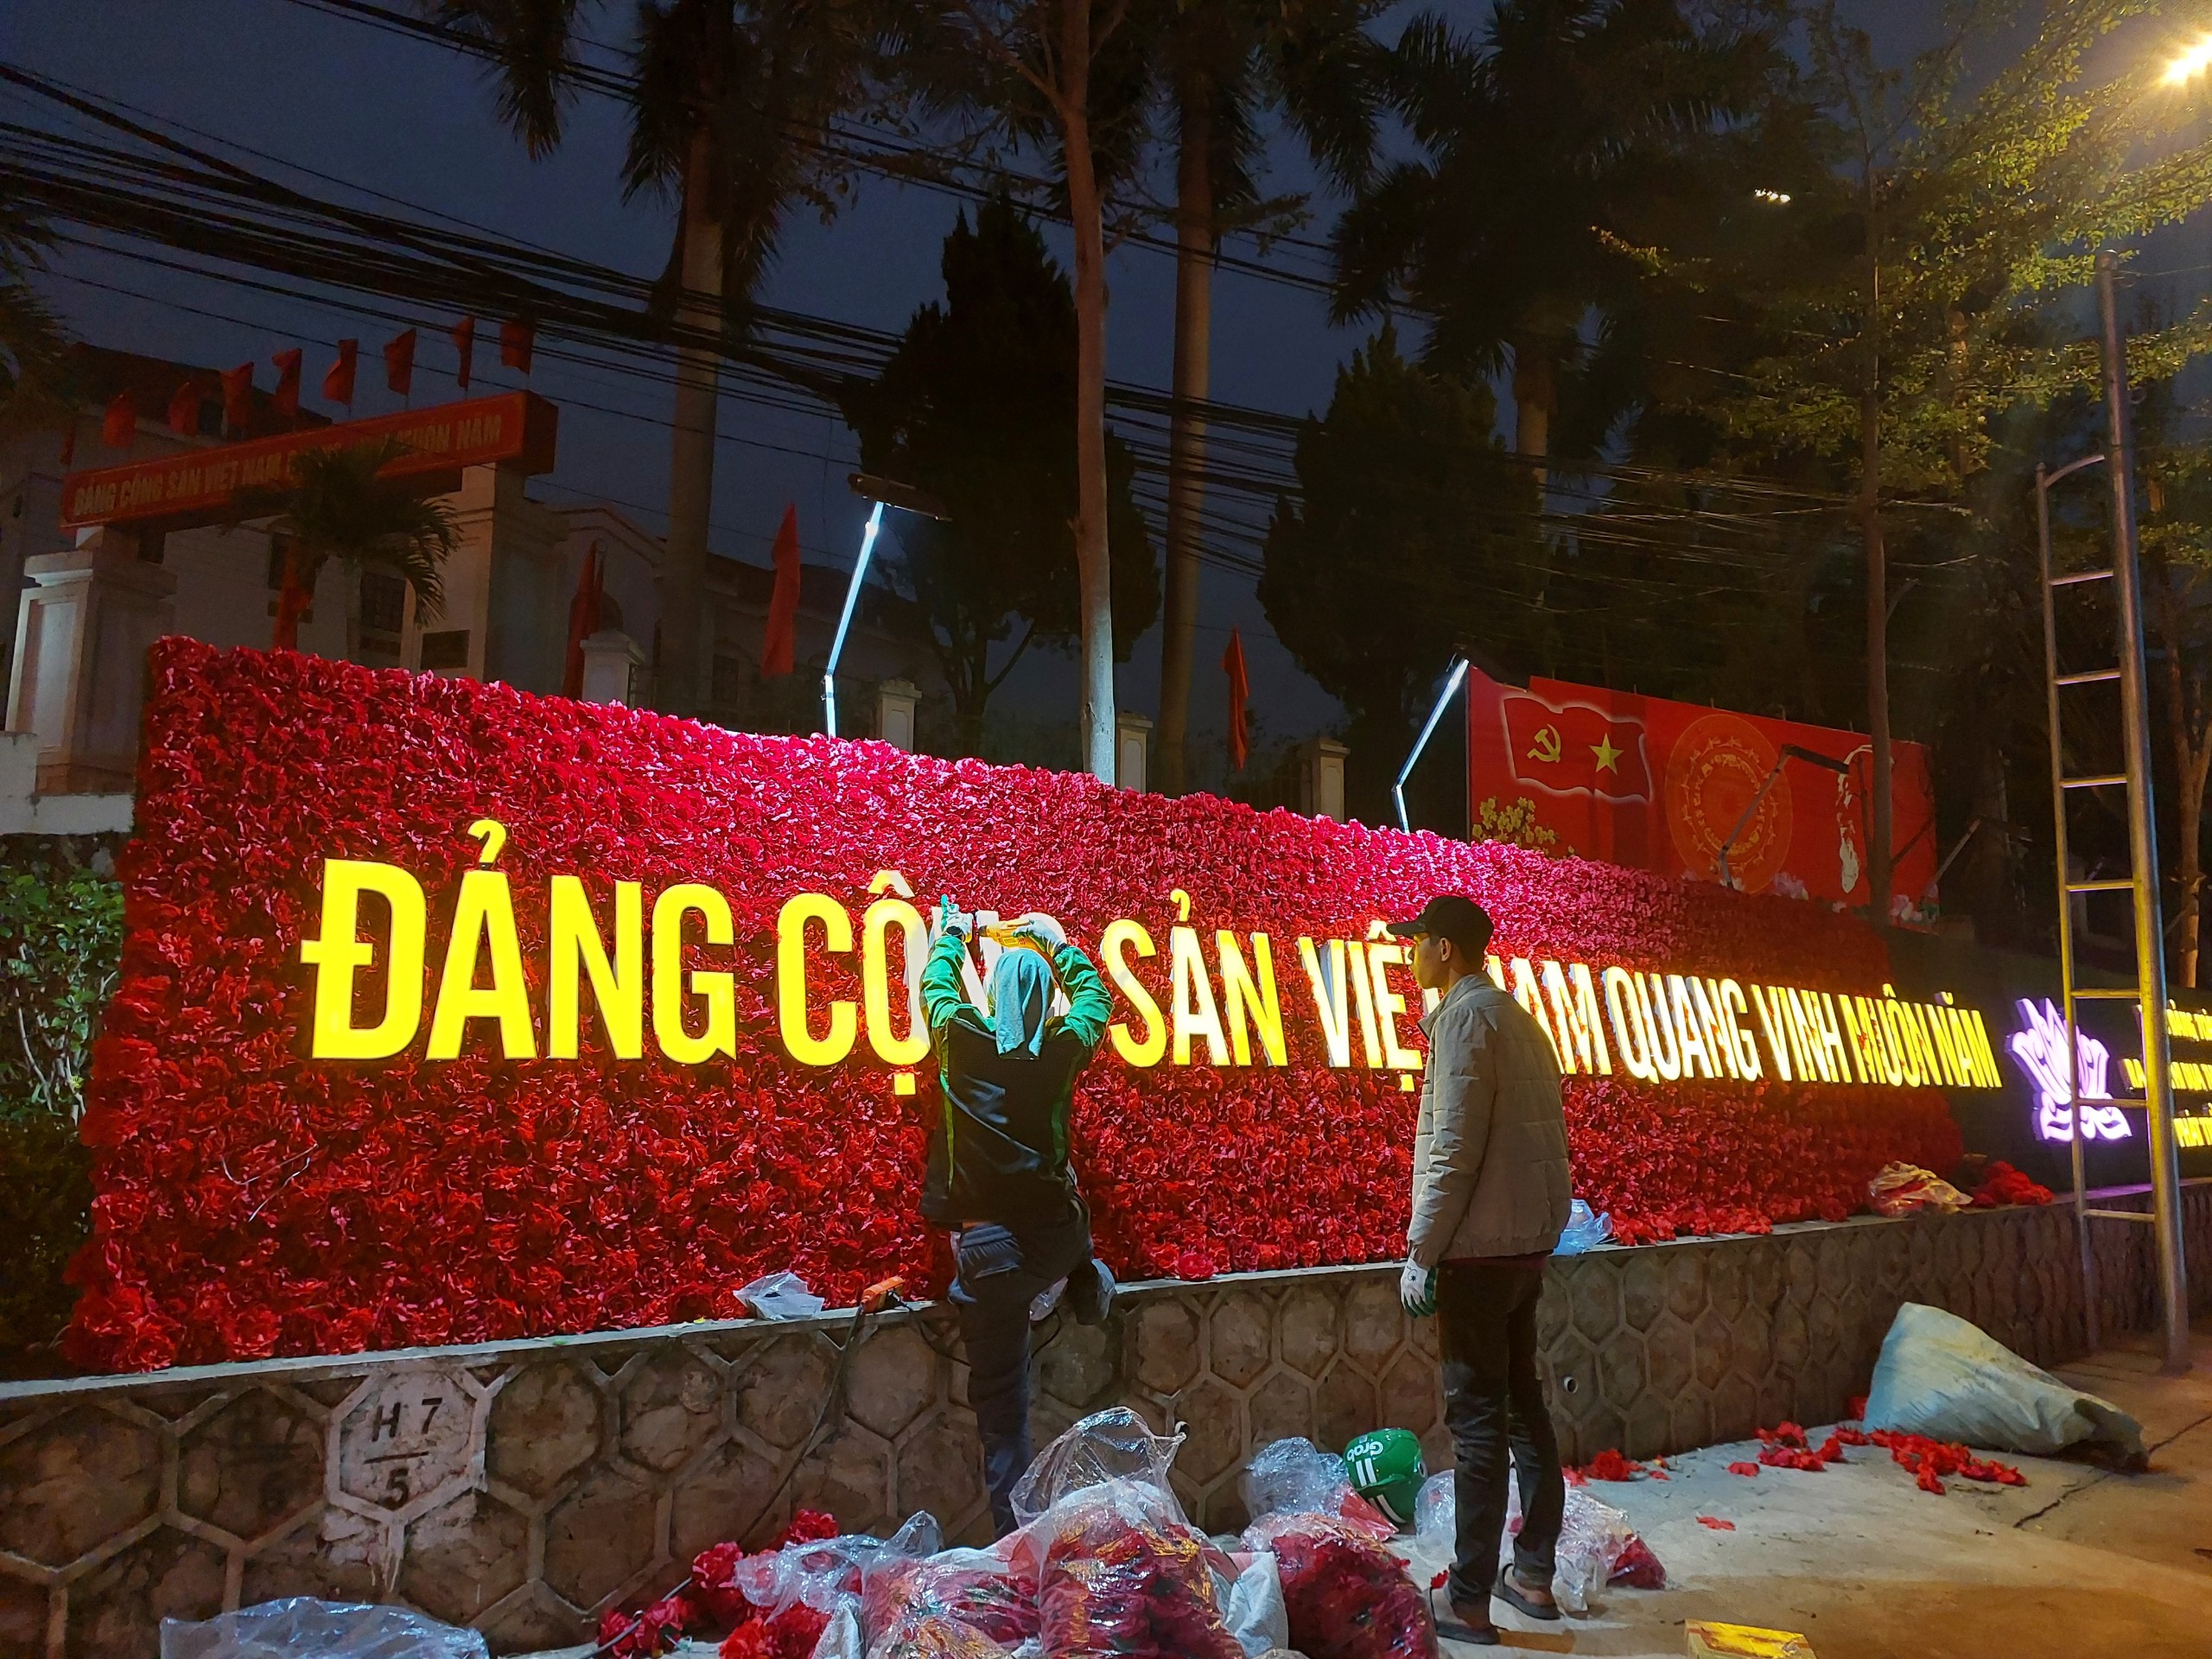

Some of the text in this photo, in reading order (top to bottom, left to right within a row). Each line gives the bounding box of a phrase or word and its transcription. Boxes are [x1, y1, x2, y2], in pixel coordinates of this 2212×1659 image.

[300, 818, 737, 1065] ĐẢNG
[777, 868, 1069, 1096] CỘ
[1100, 889, 1288, 1068] SẢN
[1296, 920, 1441, 1093] VIỆ
[1602, 966, 1764, 1084] QUANG
[1751, 984, 1853, 1084] VINH
[1838, 983, 1942, 1087] MUÔN
[1925, 991, 2002, 1088] NĂM
[1346, 1440, 1384, 1462] Grab
